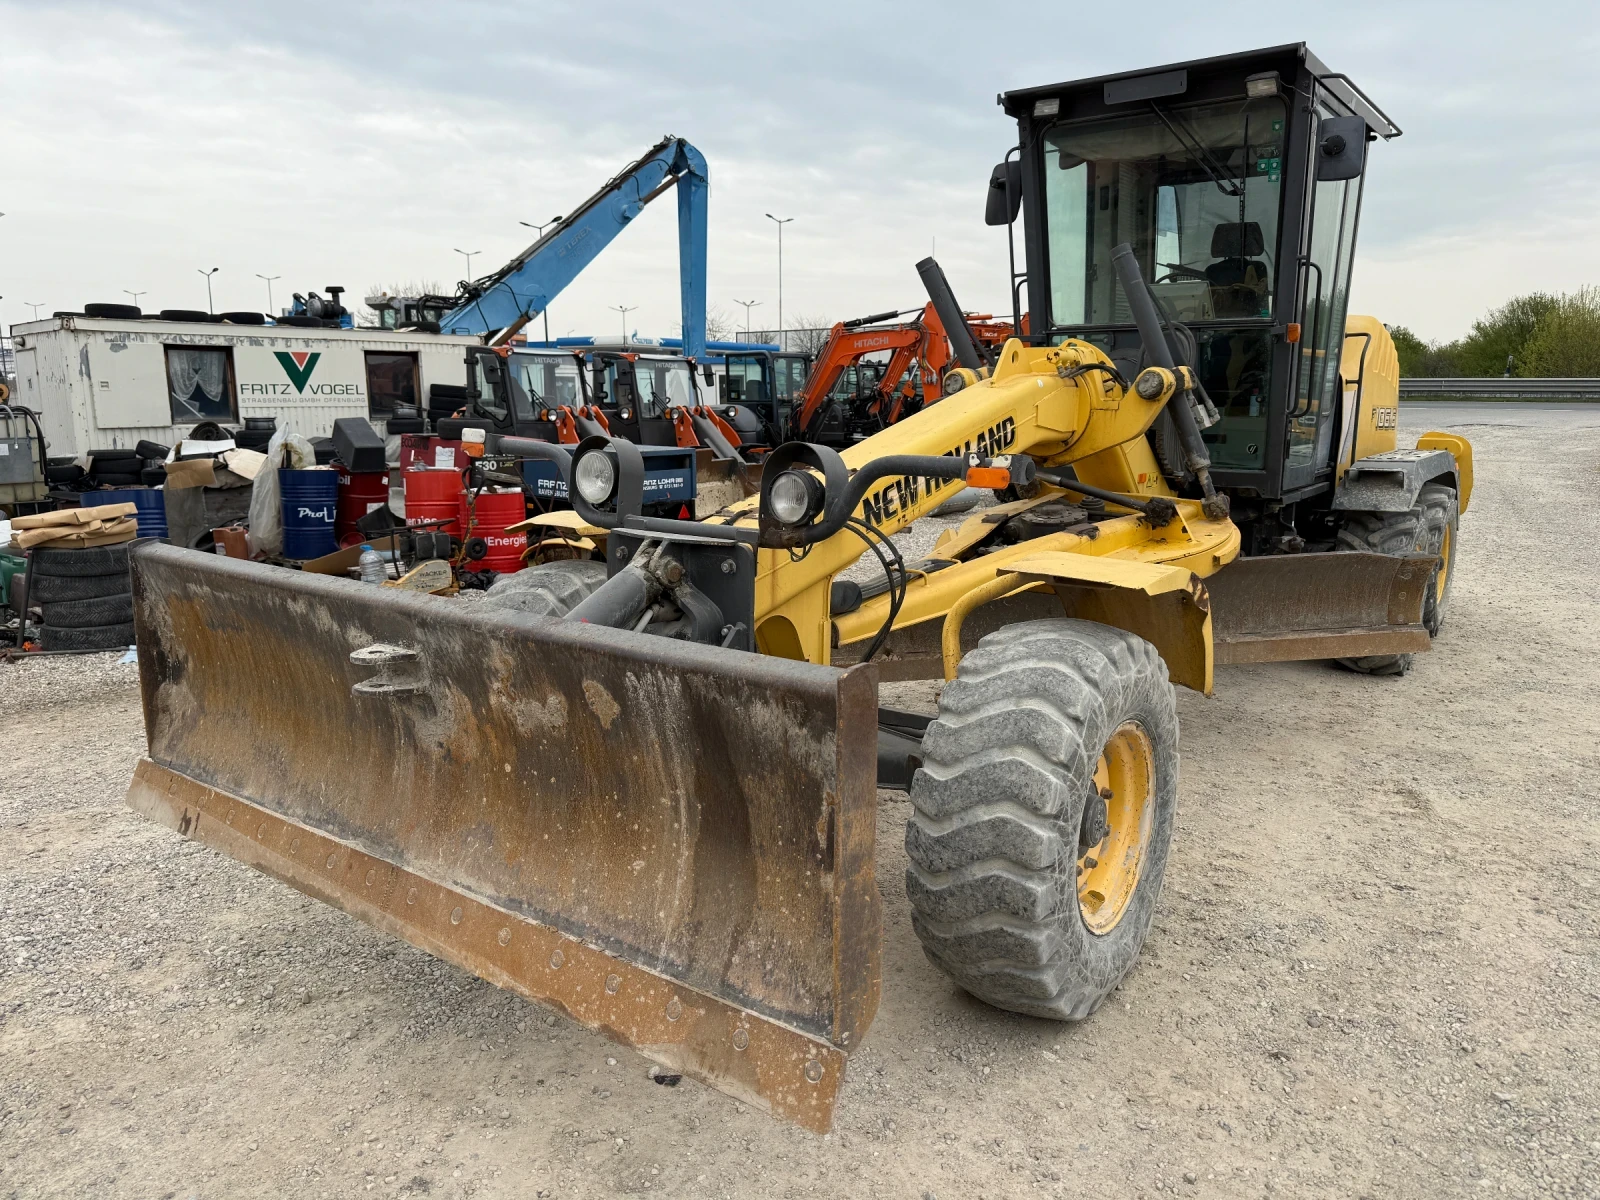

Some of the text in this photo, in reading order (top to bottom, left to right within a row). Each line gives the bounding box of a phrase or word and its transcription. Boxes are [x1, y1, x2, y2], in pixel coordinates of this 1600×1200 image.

[564, 224, 592, 249] TEREX
[854, 336, 889, 348] HITACHI
[240, 383, 365, 395] FRITZ VOGEL
[337, 474, 351, 486] bil
[537, 479, 568, 490] FRANZ
[862, 475, 919, 529] NEW
[297, 506, 338, 523] ProLi
